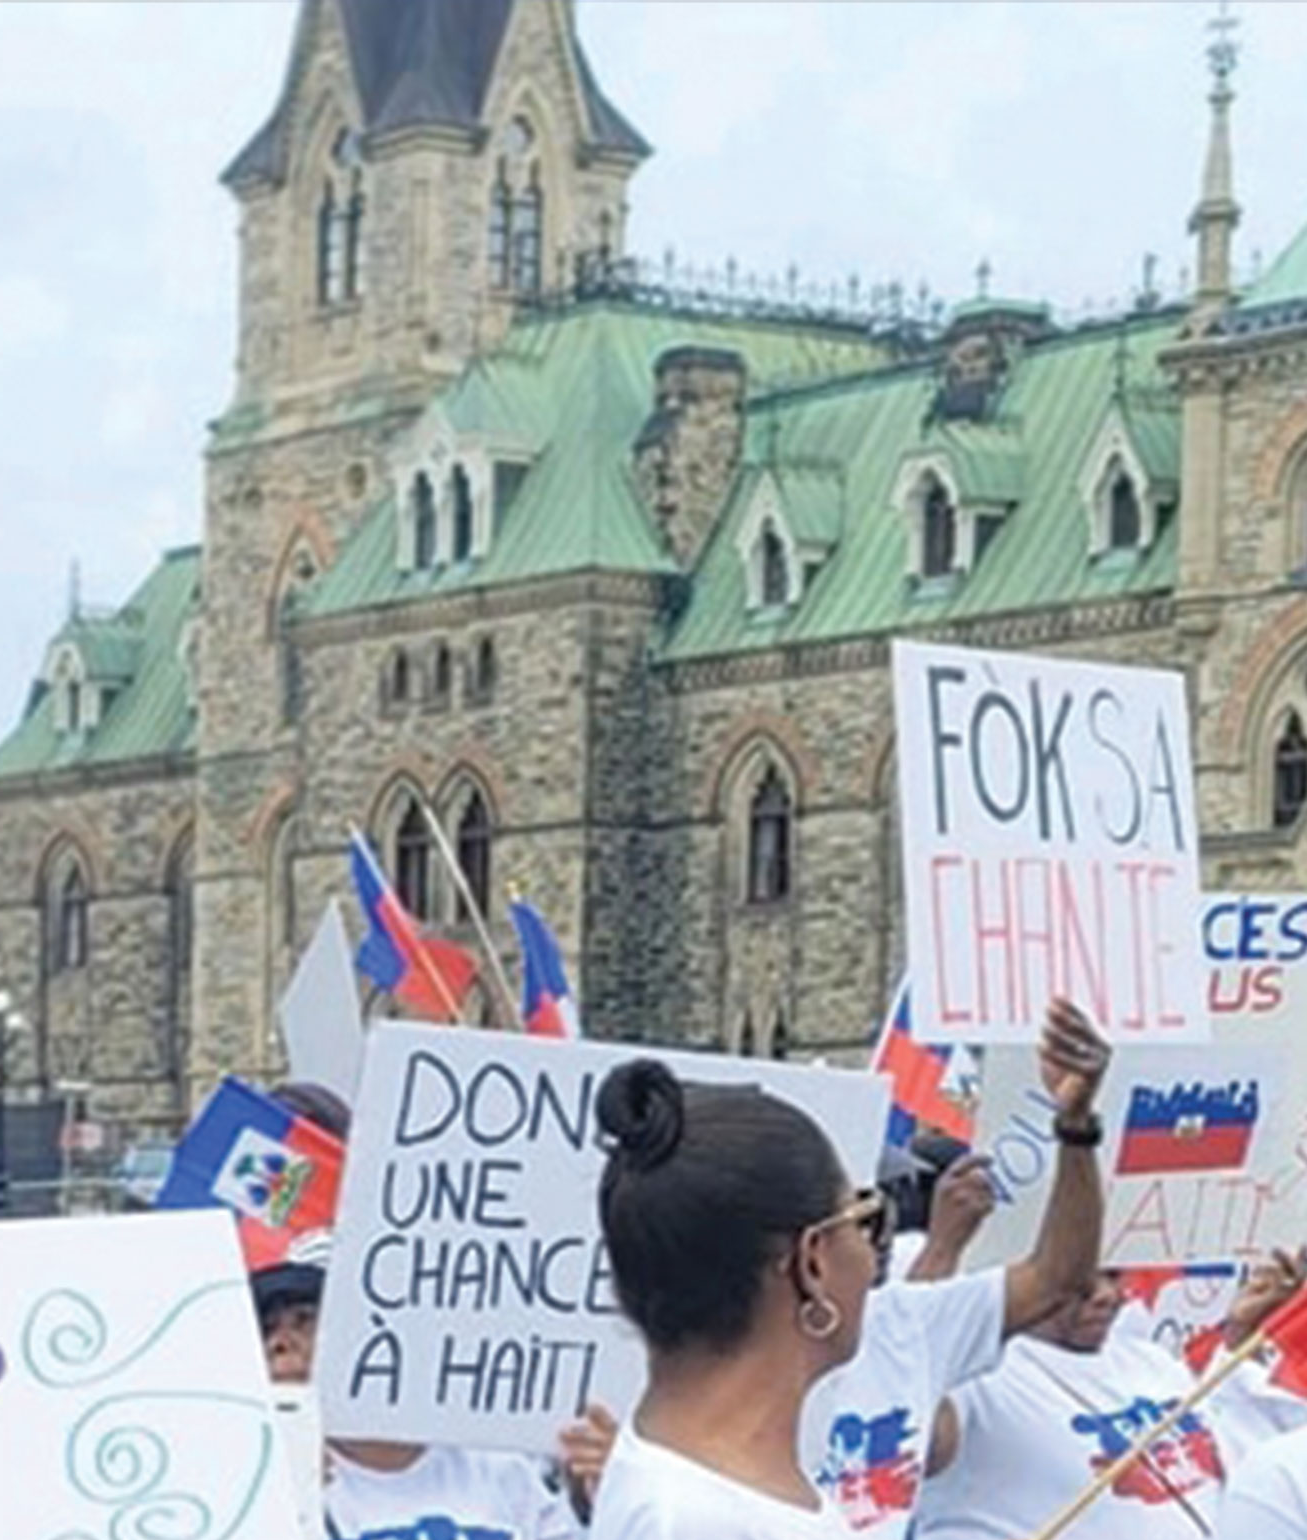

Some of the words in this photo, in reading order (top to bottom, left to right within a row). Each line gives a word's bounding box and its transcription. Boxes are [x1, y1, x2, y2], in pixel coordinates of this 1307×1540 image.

[1208, 966, 1284, 1014] US
[393, 1051, 599, 1151] DON
[381, 1159, 526, 1229] UNE
[362, 1235, 620, 1314] CHANCE
[350, 1313, 403, 1405] À
